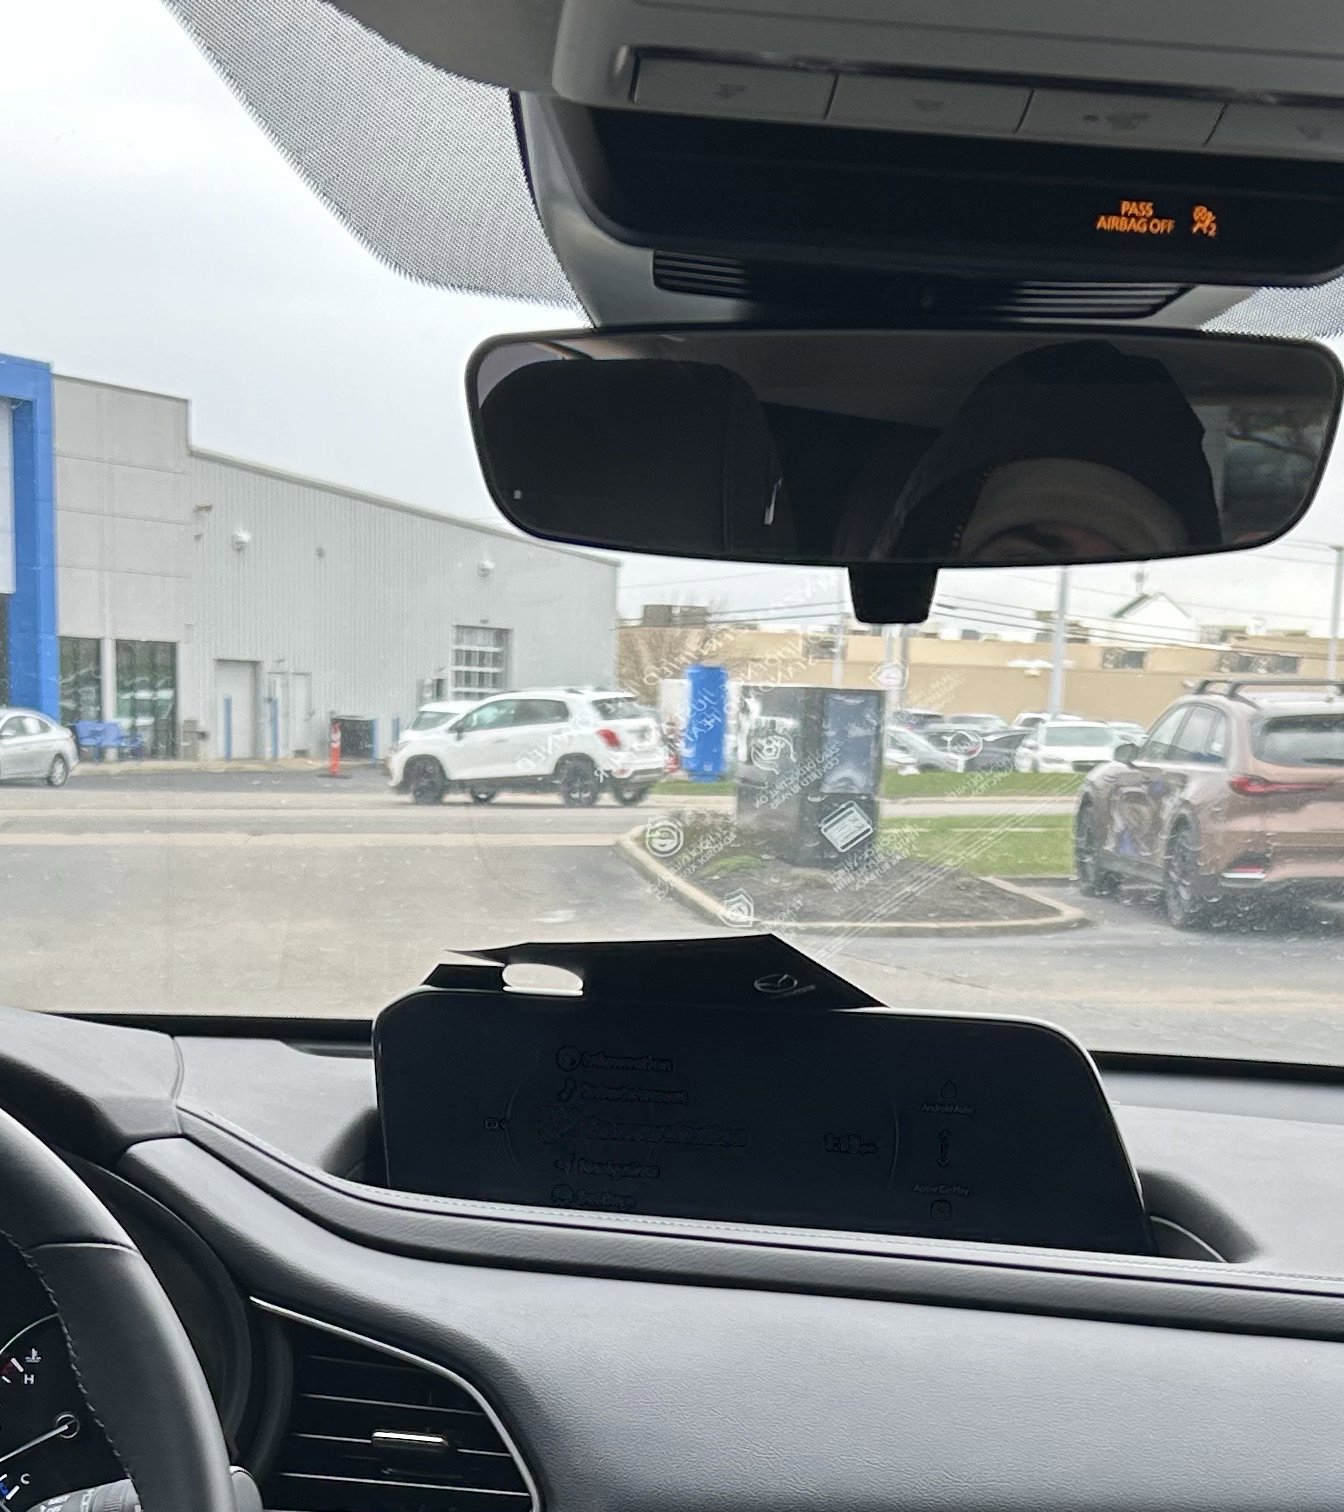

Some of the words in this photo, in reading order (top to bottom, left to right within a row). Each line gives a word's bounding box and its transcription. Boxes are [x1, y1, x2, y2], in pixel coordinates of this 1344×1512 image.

[1121, 200, 1155, 218] PASS
[1096, 215, 1148, 234] AIRBAG
[1149, 218, 1177, 235] OFF
[23, 1373, 35, 1385] H
[20, 1473, 31, 1486] C
